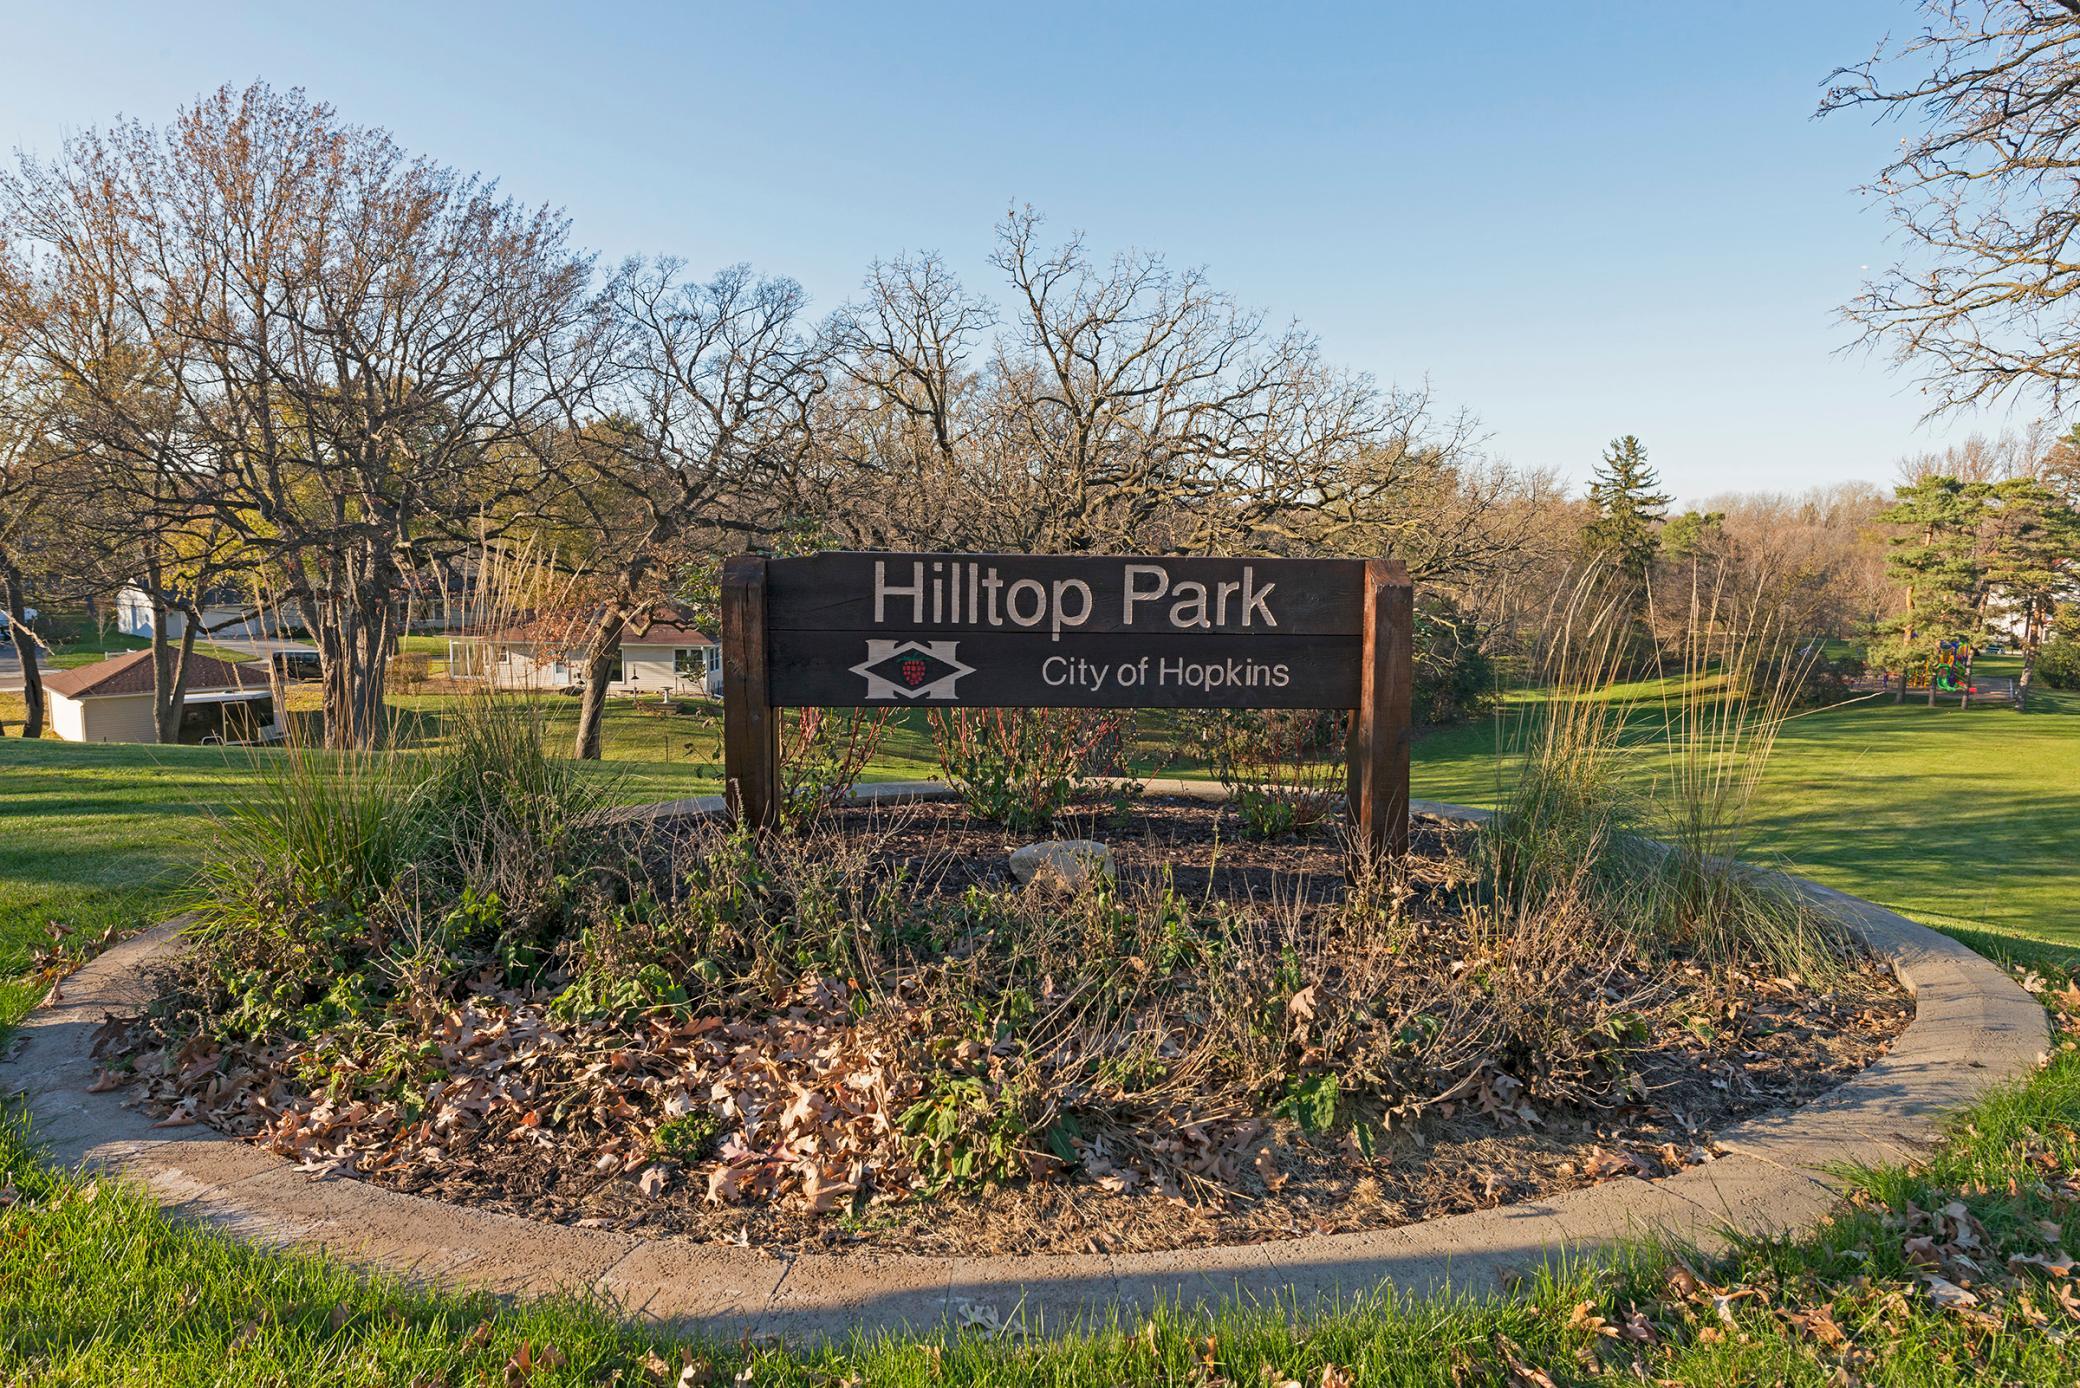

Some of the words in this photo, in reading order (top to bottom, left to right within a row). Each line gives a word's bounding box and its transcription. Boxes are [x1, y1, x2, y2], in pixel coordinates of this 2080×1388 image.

[874, 560, 1093, 642] Hilltop
[1122, 563, 1279, 628] Park
[1042, 656, 1108, 692] City
[1117, 656, 1149, 687] of
[1159, 657, 1290, 692] Hopkins
